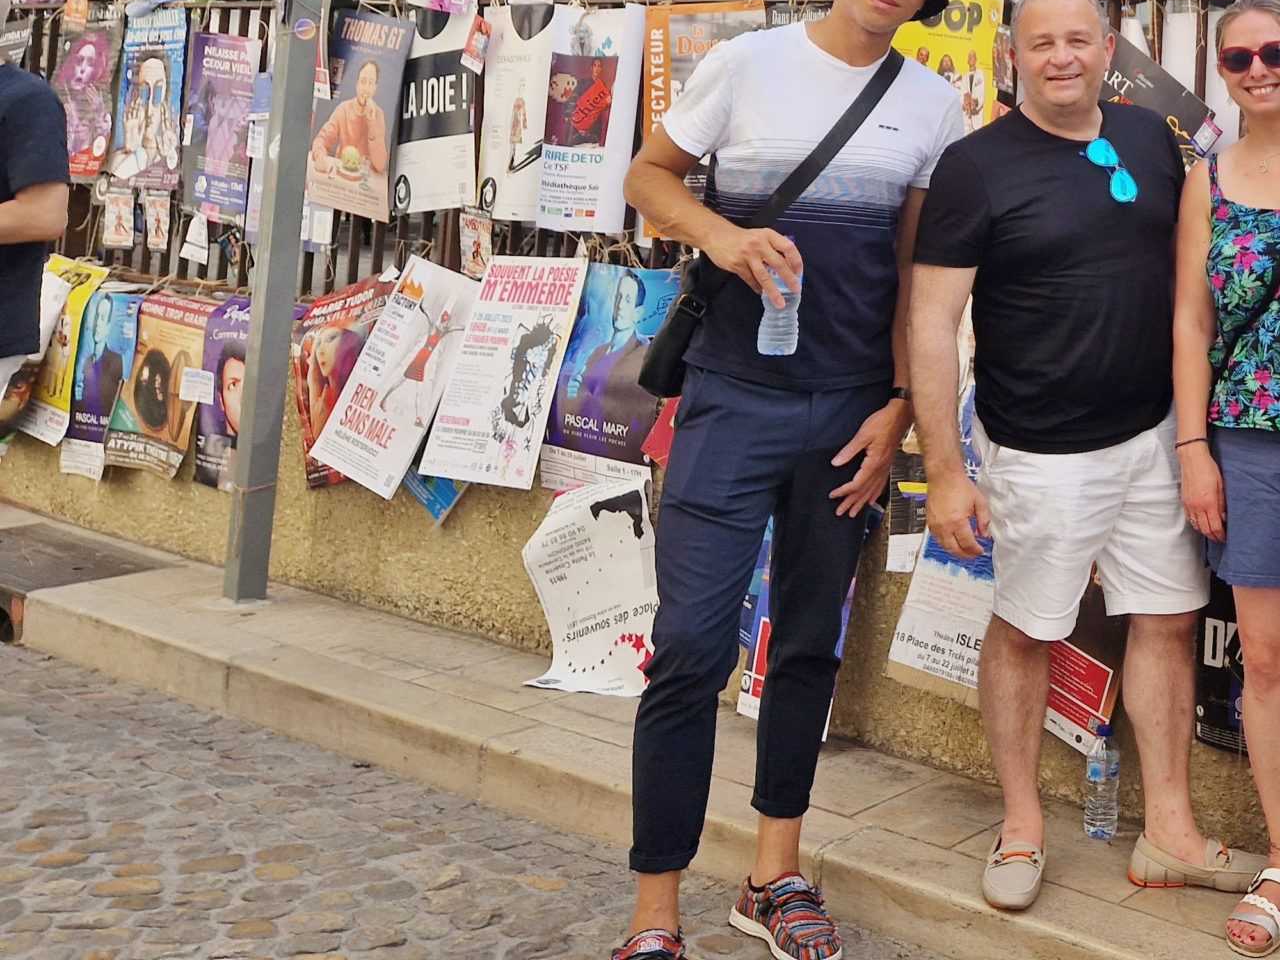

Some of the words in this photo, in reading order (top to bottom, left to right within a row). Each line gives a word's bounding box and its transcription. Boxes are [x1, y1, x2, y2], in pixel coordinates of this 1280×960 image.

[341, 17, 386, 43] THOMAS
[421, 75, 456, 113] JOIE
[572, 90, 607, 124] Chien
[545, 150, 568, 161] RIRE
[571, 152, 587, 163] DE
[392, 293, 418, 312] FACTORY
[351, 383, 378, 411] RIEN
[340, 405, 370, 436] SANS
[368, 418, 396, 450] MÂLE
[564, 413, 599, 431] PASCAL
[602, 421, 629, 437] MARY
